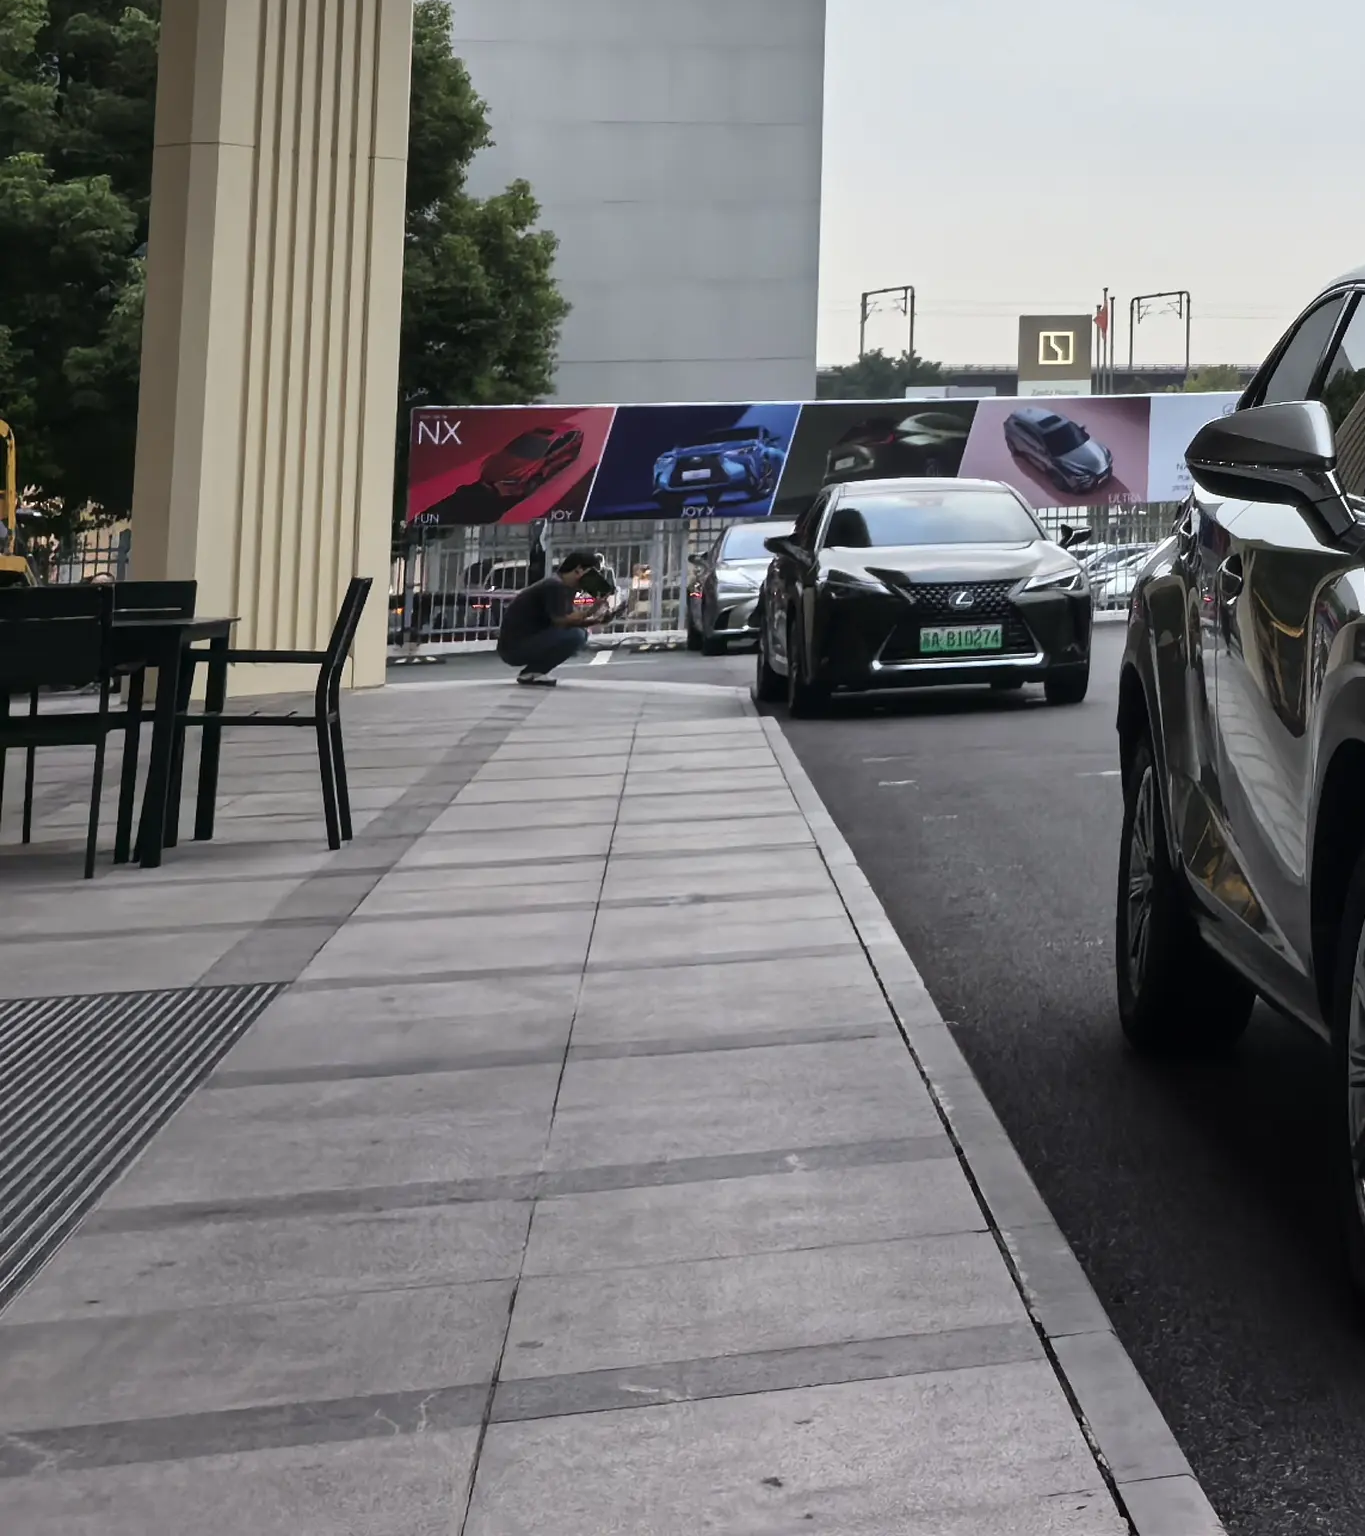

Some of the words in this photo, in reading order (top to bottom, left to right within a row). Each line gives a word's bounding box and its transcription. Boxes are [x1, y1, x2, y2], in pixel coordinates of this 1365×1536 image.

[418, 421, 462, 445] NX
[550, 510, 574, 520] JOY
[681, 506, 704, 517] JOY
[414, 514, 440, 524] FUN
